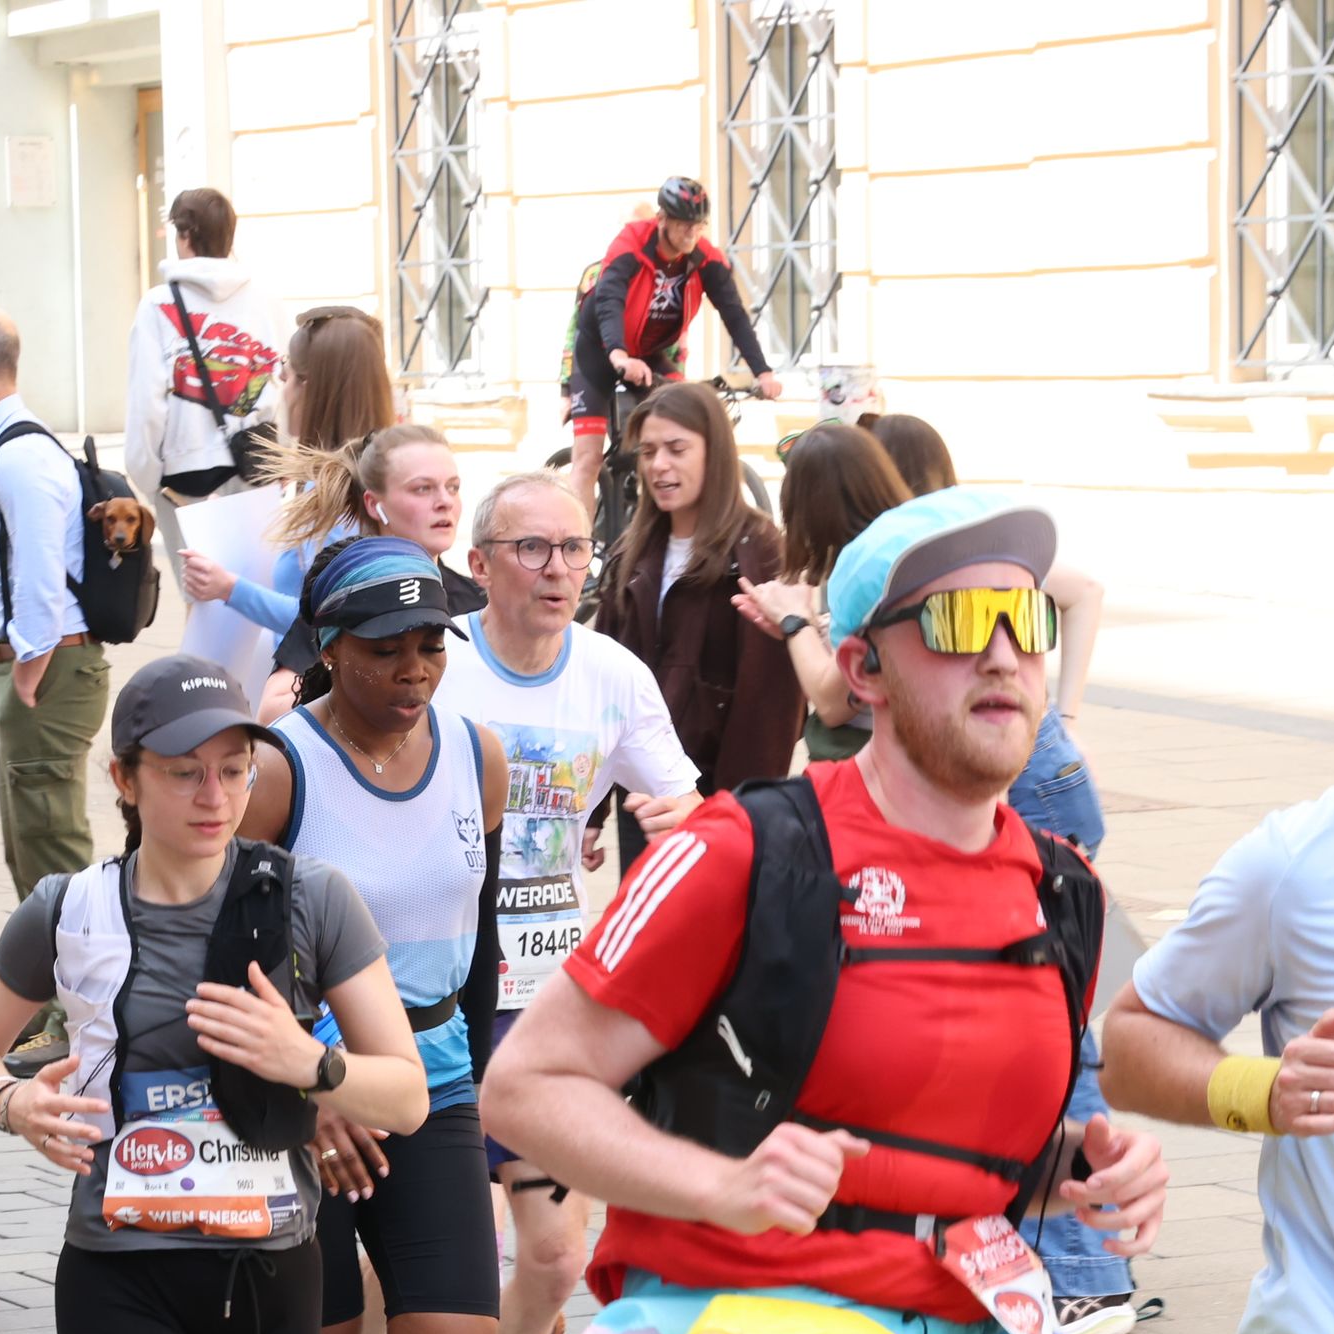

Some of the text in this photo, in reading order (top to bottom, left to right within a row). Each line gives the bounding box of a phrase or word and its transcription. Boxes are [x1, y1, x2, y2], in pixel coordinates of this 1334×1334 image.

[181, 676, 228, 692] KIPRUN
[496, 881, 575, 908] WERADE
[516, 987, 534, 995] Wien
[517, 979, 535, 987] Stadt
[122, 1137, 187, 1166] Hervis
[130, 1160, 154, 1170] SPORTS
[148, 1210, 194, 1224] WIEN
[198, 1208, 263, 1225] ENERGIE
